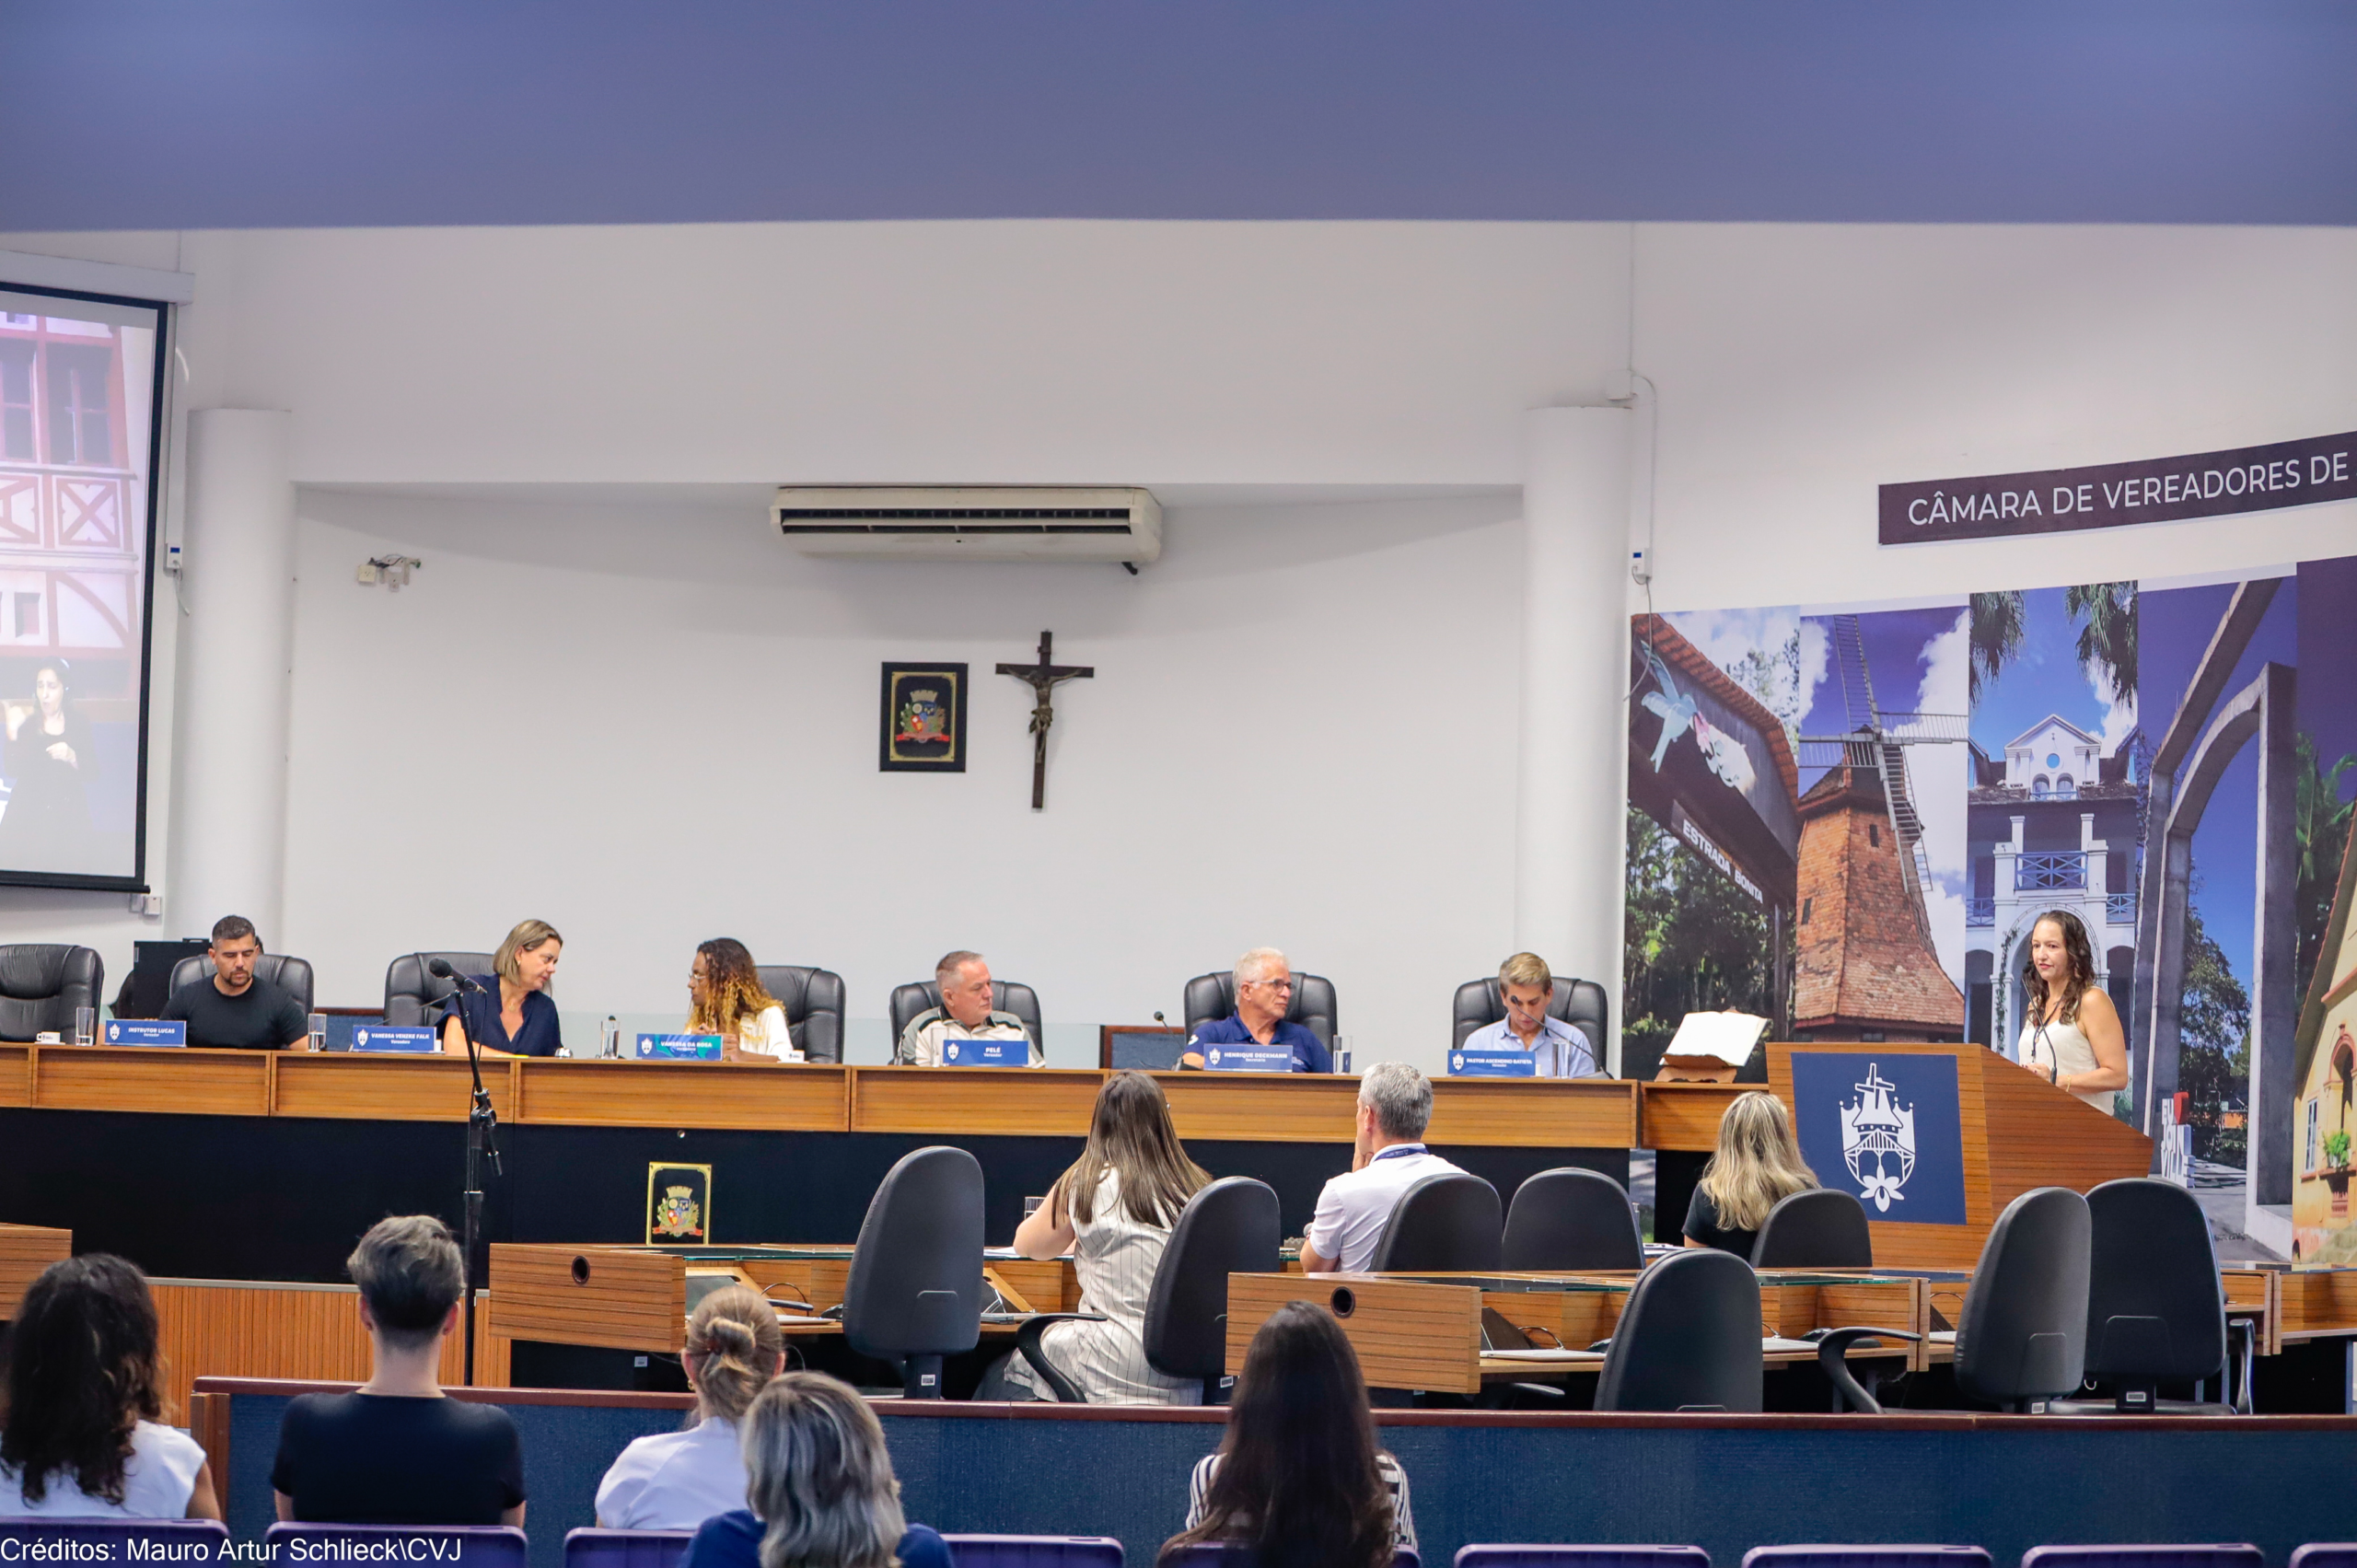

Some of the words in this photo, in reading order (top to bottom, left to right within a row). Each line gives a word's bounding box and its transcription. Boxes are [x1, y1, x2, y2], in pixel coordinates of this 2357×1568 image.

[1908, 490, 2043, 526] CÂMARA
[2052, 484, 2094, 515] DE
[2102, 459, 2301, 509] VEREADORES
[2310, 452, 2349, 485] DE
[1682, 819, 1731, 877] ESTRADA
[1734, 868, 1763, 904] BONITA
